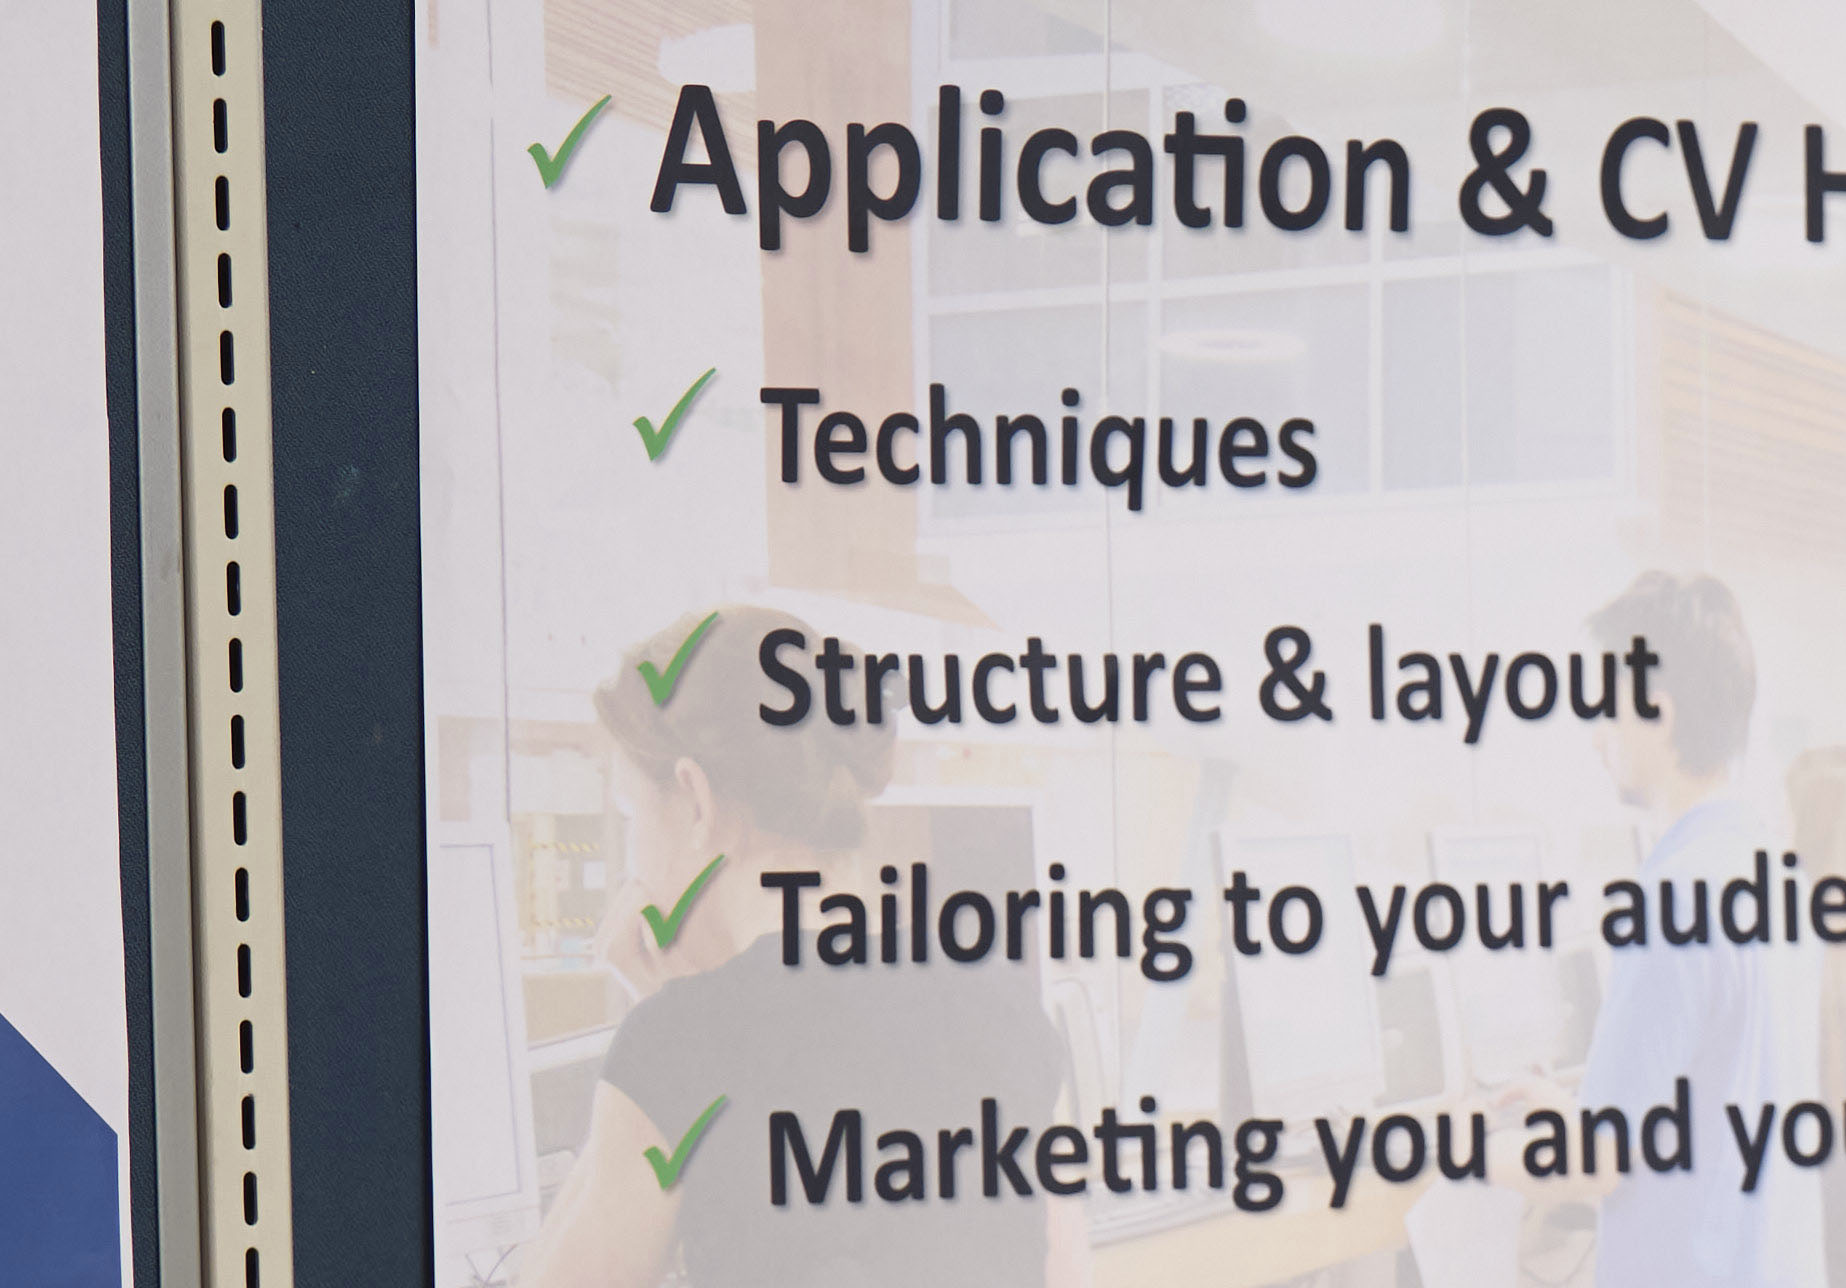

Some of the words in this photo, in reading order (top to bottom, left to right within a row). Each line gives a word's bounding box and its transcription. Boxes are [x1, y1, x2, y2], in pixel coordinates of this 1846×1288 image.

[651, 85, 1409, 253] Application
[1460, 109, 1553, 237] &
[1601, 118, 1757, 240] CV
[761, 384, 1316, 511] Techniques
[760, 629, 1221, 726] Structure
[1260, 627, 1332, 721] &
[1370, 625, 1659, 744] layout
[761, 863, 1192, 981] Tailoring
[1225, 873, 1322, 955] to
[1357, 883, 1567, 976] your
[770, 1097, 1283, 1211] Marketing
[1316, 1120, 1485, 1208] you
[1524, 1078, 1691, 1177] and
